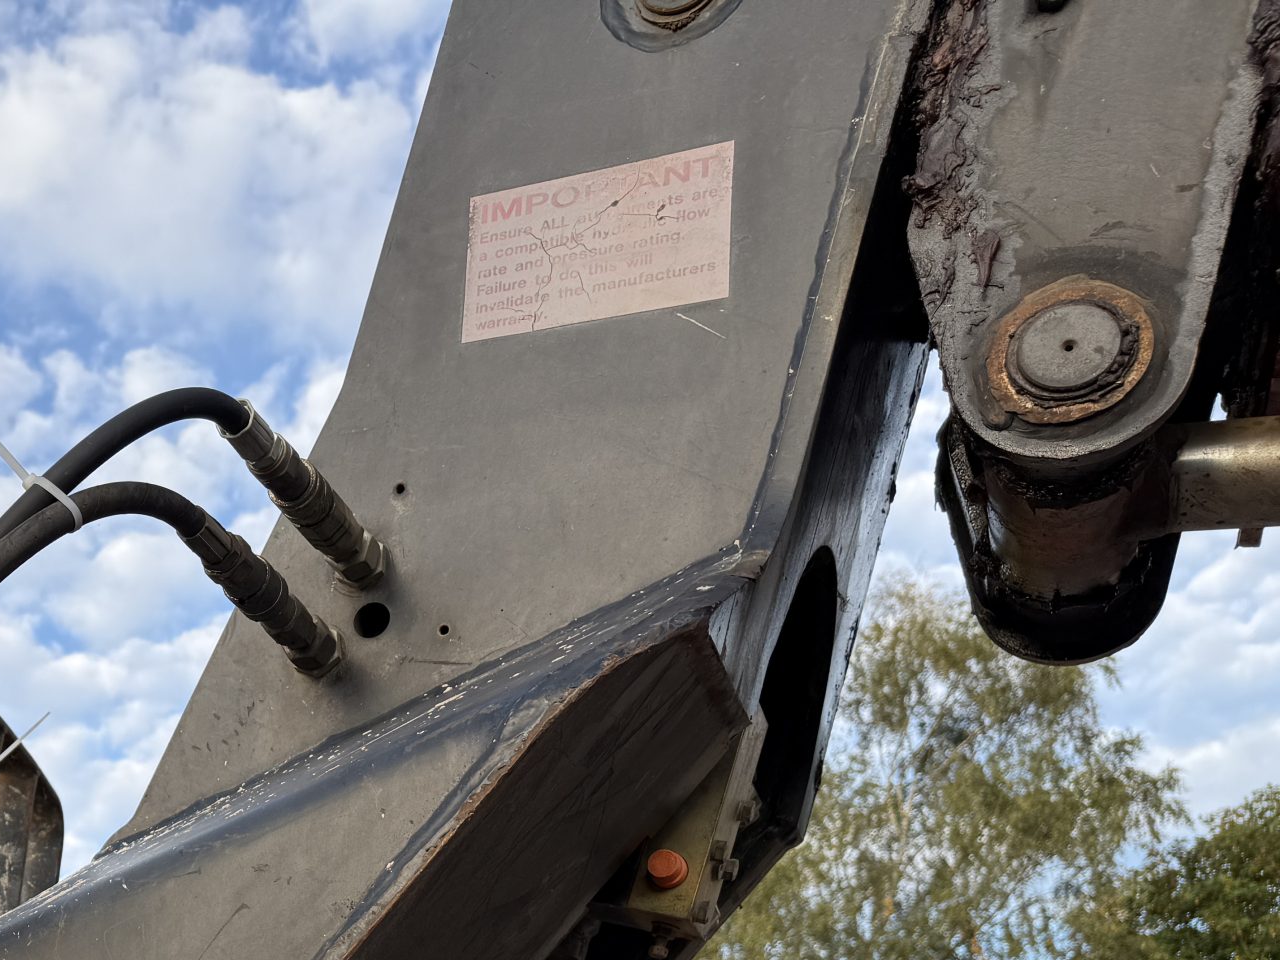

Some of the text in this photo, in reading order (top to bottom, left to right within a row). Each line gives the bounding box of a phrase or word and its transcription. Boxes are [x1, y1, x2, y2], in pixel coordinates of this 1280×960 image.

[479, 225, 532, 244] Ensure
[540, 216, 569, 232] ALL
[692, 187, 717, 202] are
[477, 264, 507, 280] rate
[515, 256, 544, 271] and
[551, 242, 624, 268] pressure
[478, 252, 487, 262] a
[495, 232, 584, 258] compatible
[475, 260, 716, 314] invalidate the manufacturers
[476, 253, 652, 297] Failure to do this will
